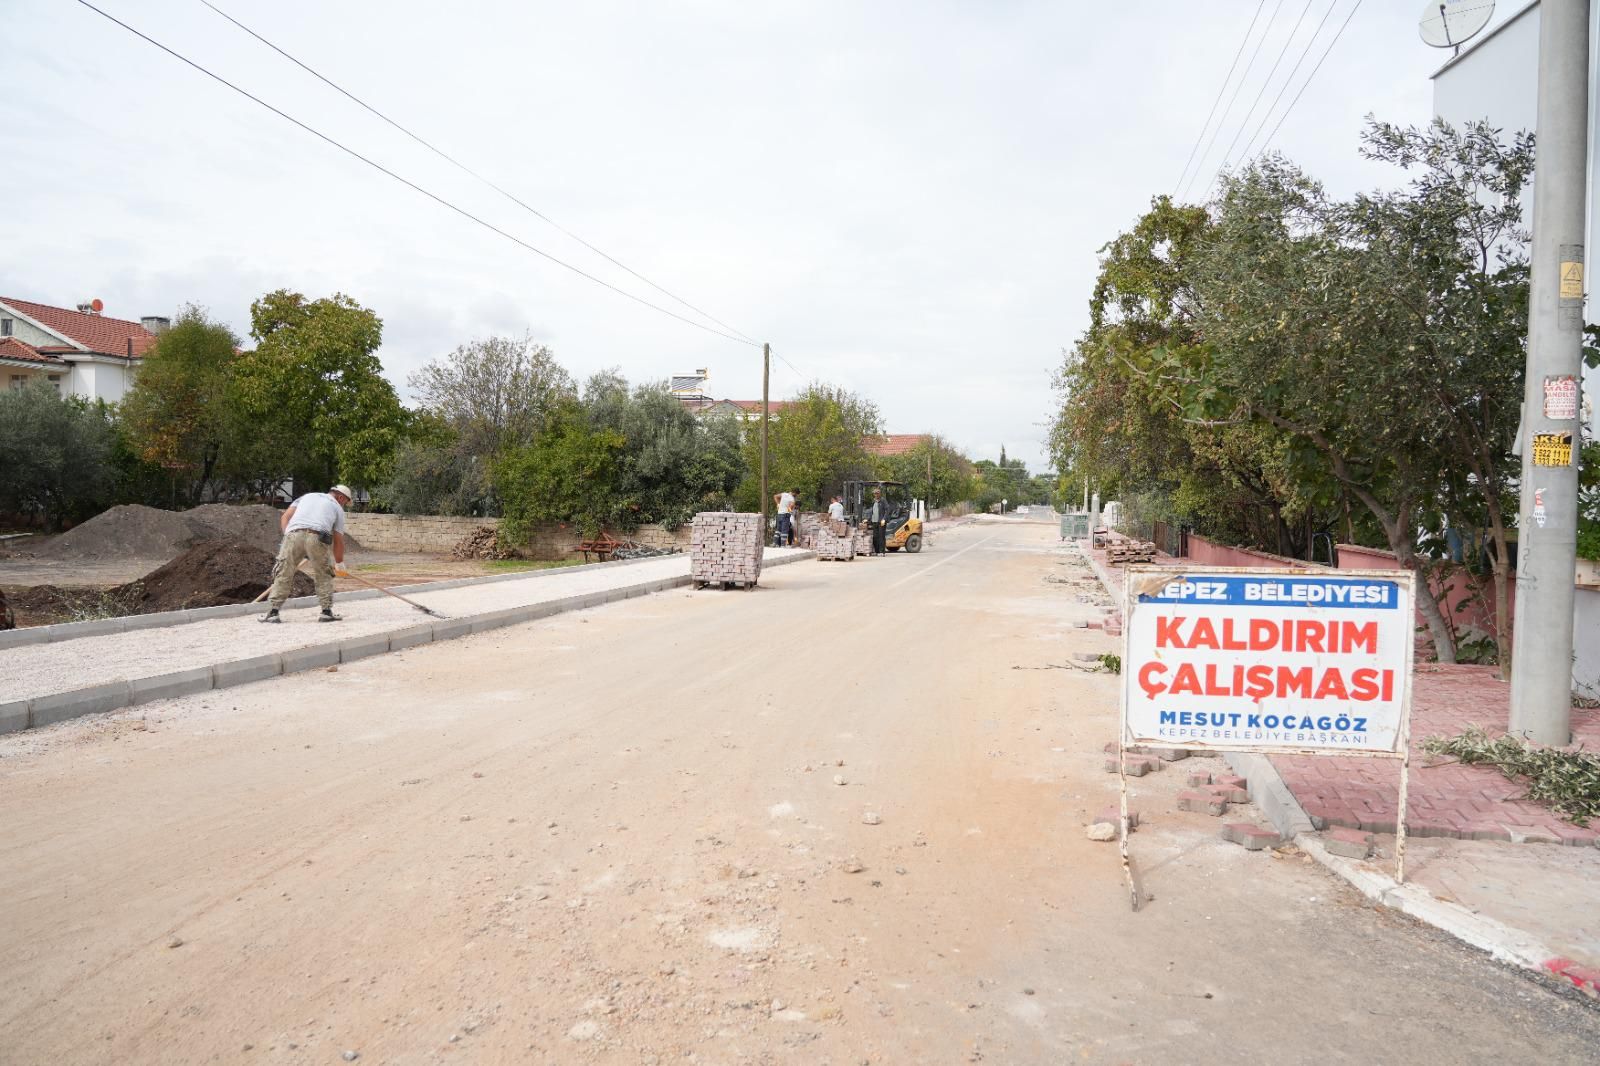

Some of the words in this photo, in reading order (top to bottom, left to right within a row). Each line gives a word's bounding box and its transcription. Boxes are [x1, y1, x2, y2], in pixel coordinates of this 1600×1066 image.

[1157, 581, 1228, 600] EPEZ
[1244, 582, 1389, 604] BELEDİYESİ
[1156, 615, 1378, 654] KALDIRIM
[1138, 661, 1394, 704] ÇALIŞMASI
[1160, 710, 1242, 727] MESUT
[1247, 713, 1368, 732] KOCAGÖZ
[1159, 727, 1208, 738] KEPEZ
[1213, 729, 1292, 741] BELEDİYE
[1297, 732, 1368, 744] BAŞKANI
